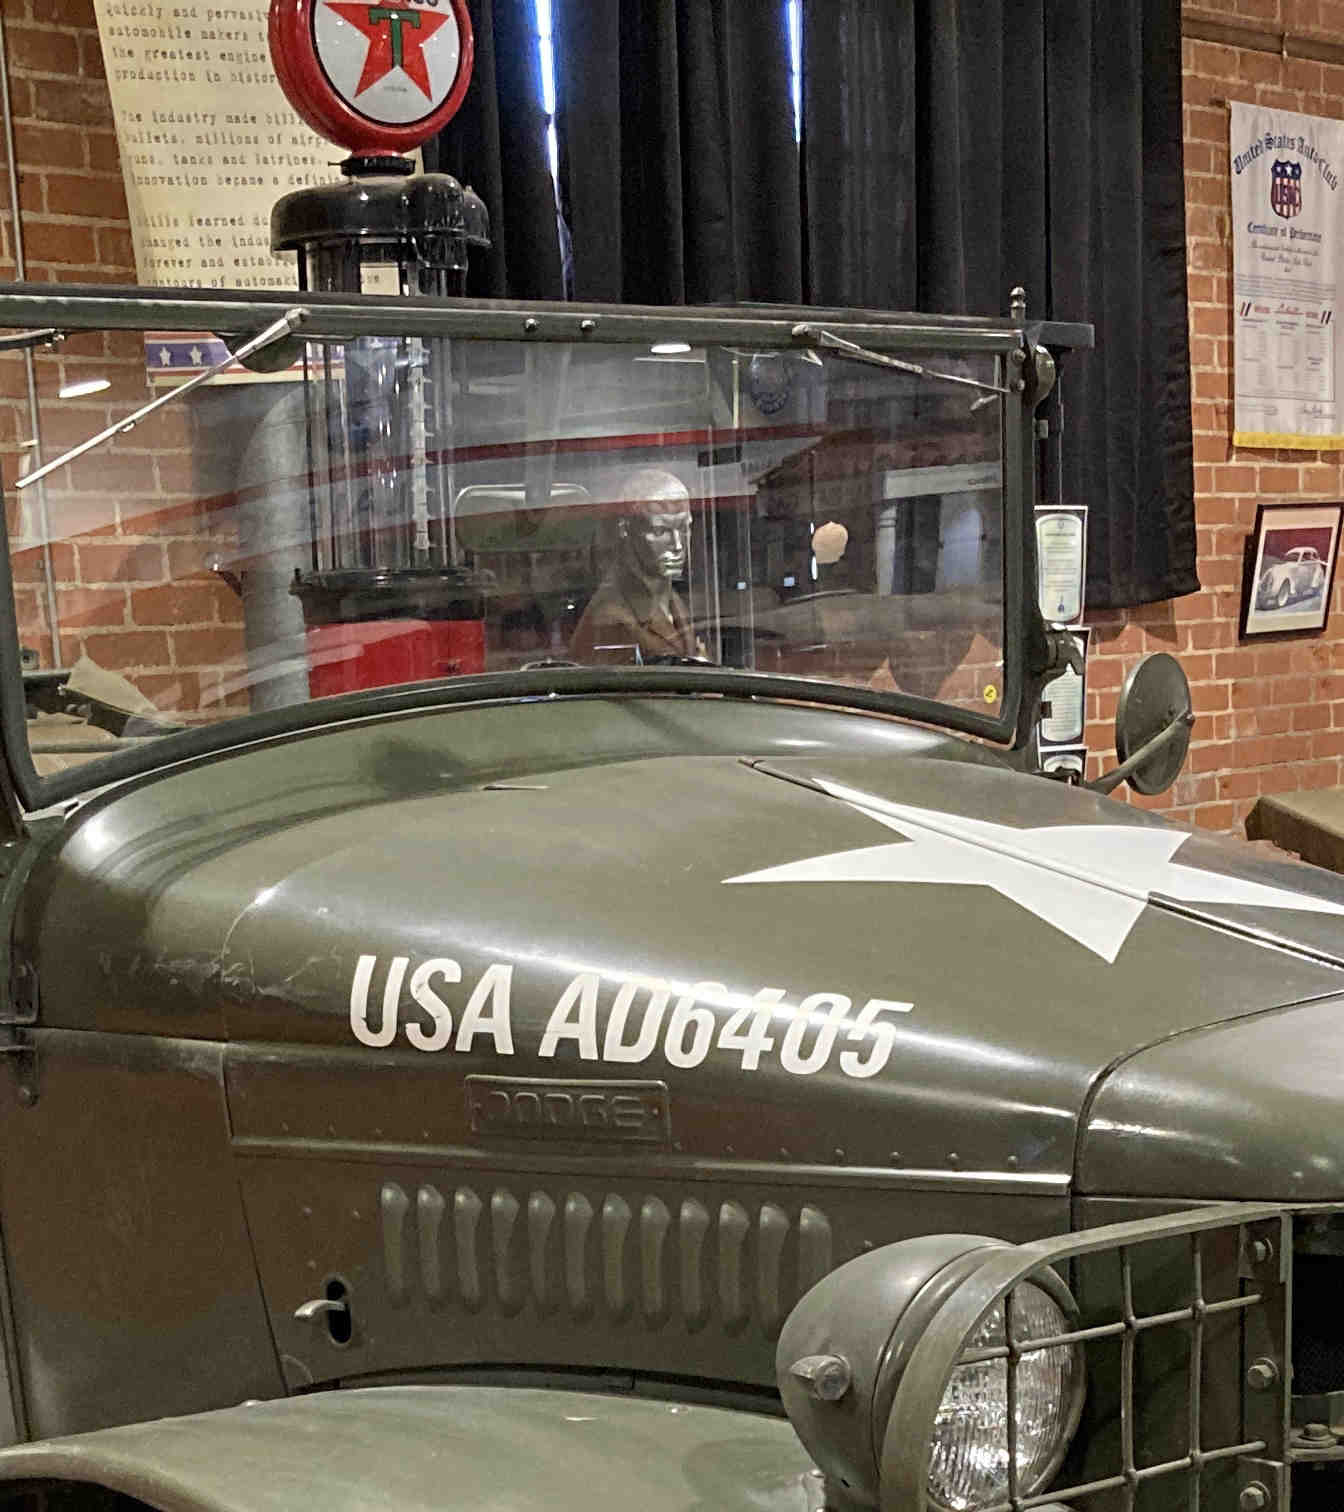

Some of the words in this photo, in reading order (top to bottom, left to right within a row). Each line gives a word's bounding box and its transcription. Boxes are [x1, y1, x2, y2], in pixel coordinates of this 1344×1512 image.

[173, 6, 199, 18] and
[144, 49, 210, 63] greatest
[220, 51, 266, 64] engine
[114, 68, 196, 82] production
[152, 111, 216, 126] industry
[225, 112, 257, 125] made
[196, 132, 259, 146] millions
[223, 155, 248, 166] and
[349, 954, 515, 1057] USA
[537, 973, 914, 1079] AD6405
